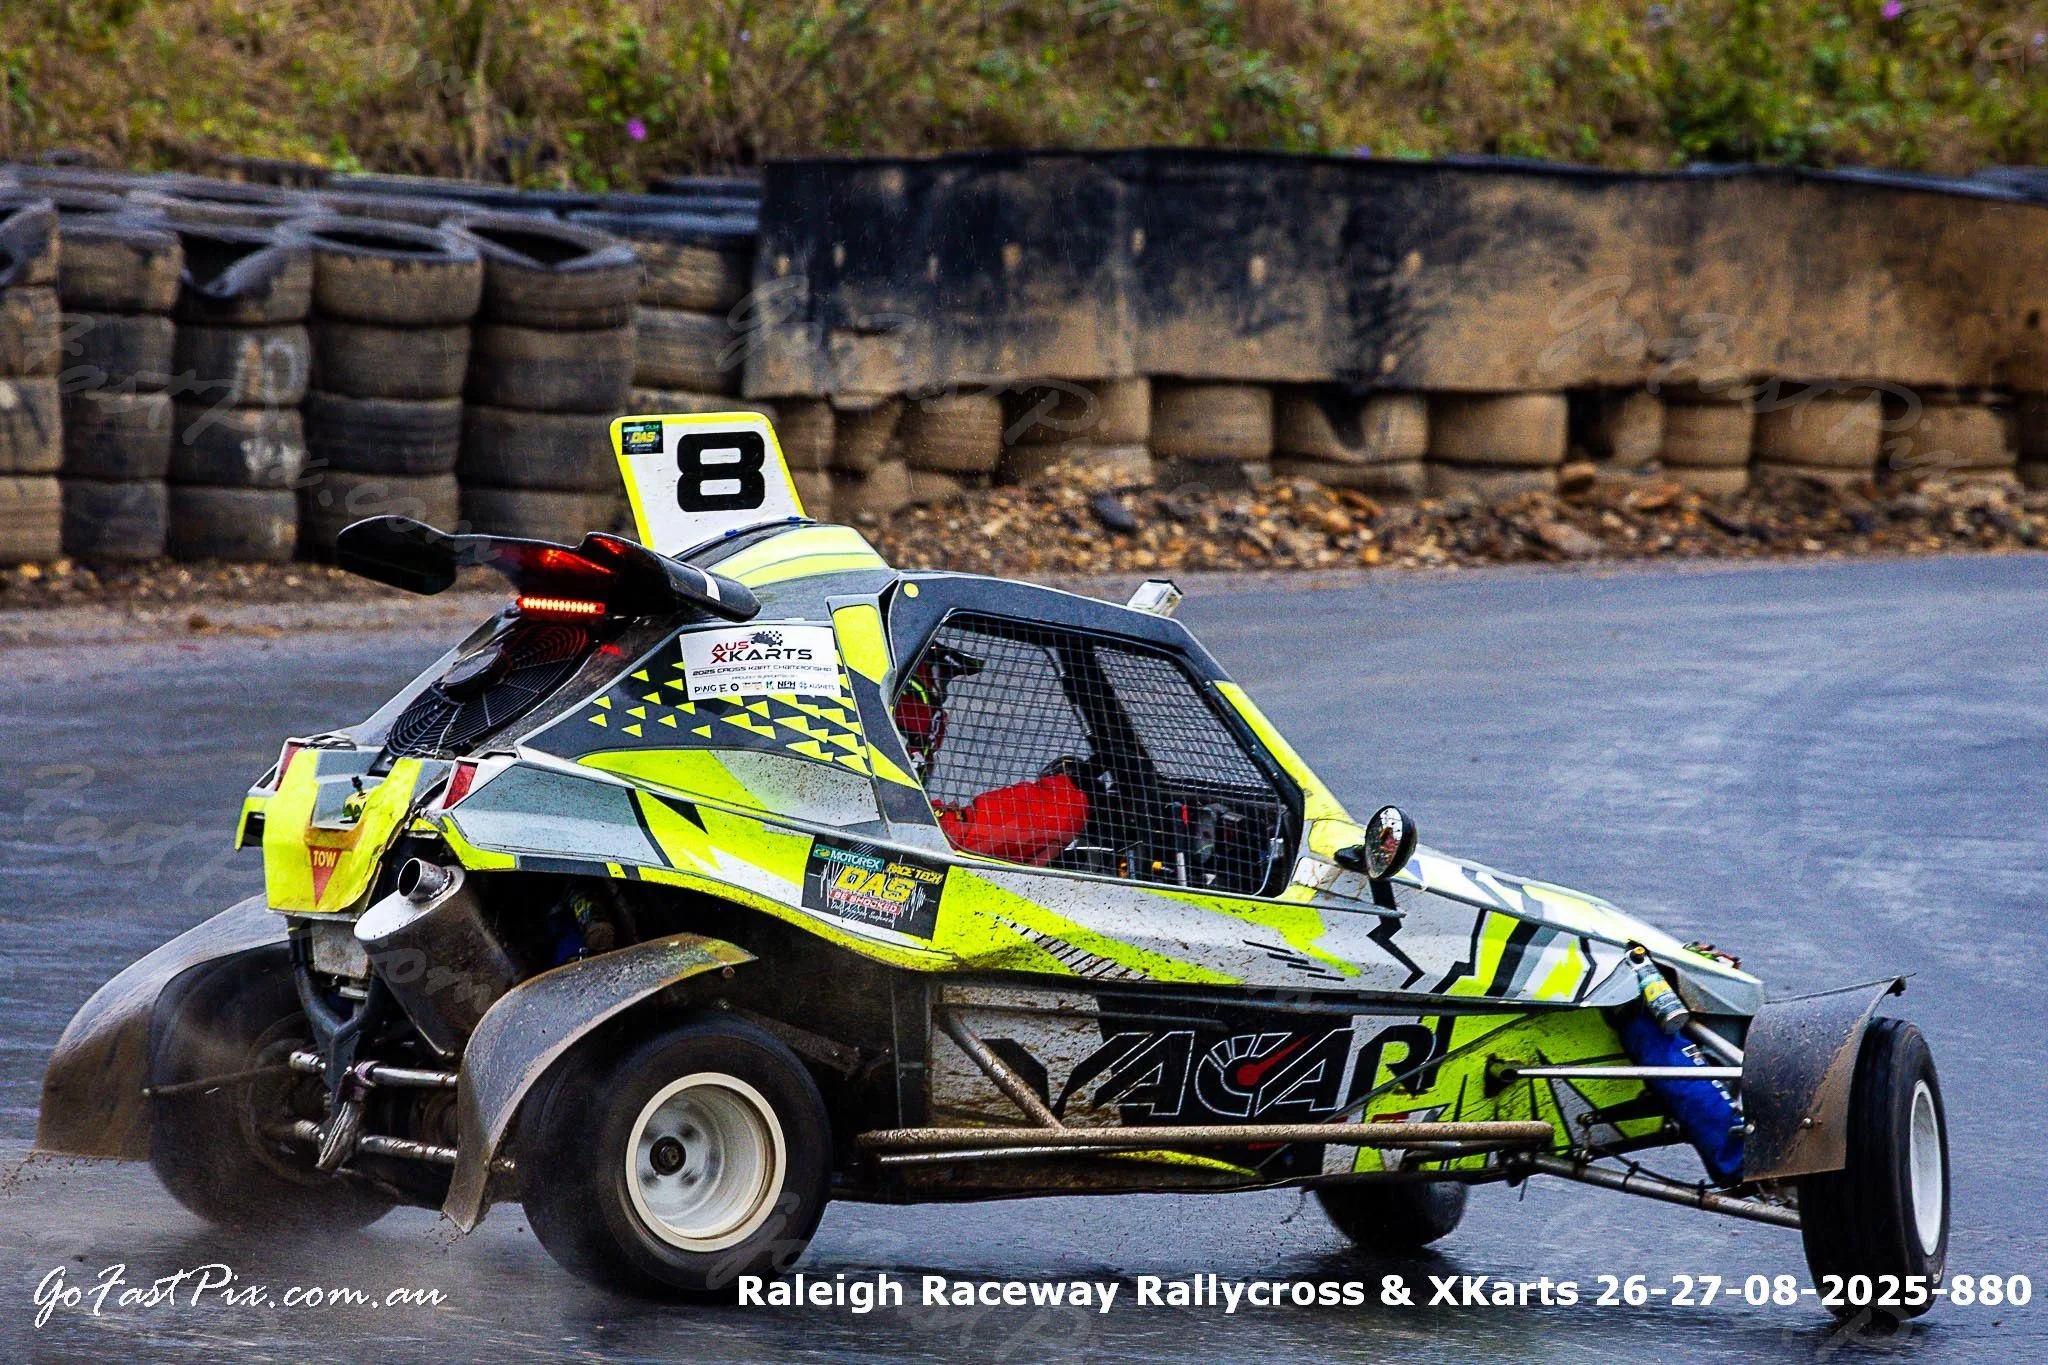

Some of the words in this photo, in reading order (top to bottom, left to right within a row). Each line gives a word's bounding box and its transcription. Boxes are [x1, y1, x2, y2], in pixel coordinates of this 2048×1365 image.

[677, 431, 765, 512] 8
[711, 640, 750, 653] AUS
[711, 648, 813, 664] XKARTS
[692, 668, 716, 676] 2025
[313, 850, 337, 867] TOW
[830, 850, 881, 869] MOTOREX
[886, 862, 915, 877] RACE
[914, 868, 944, 885] TECH
[833, 865, 917, 903] DAS
[850, 893, 898, 913] SHOCKED
